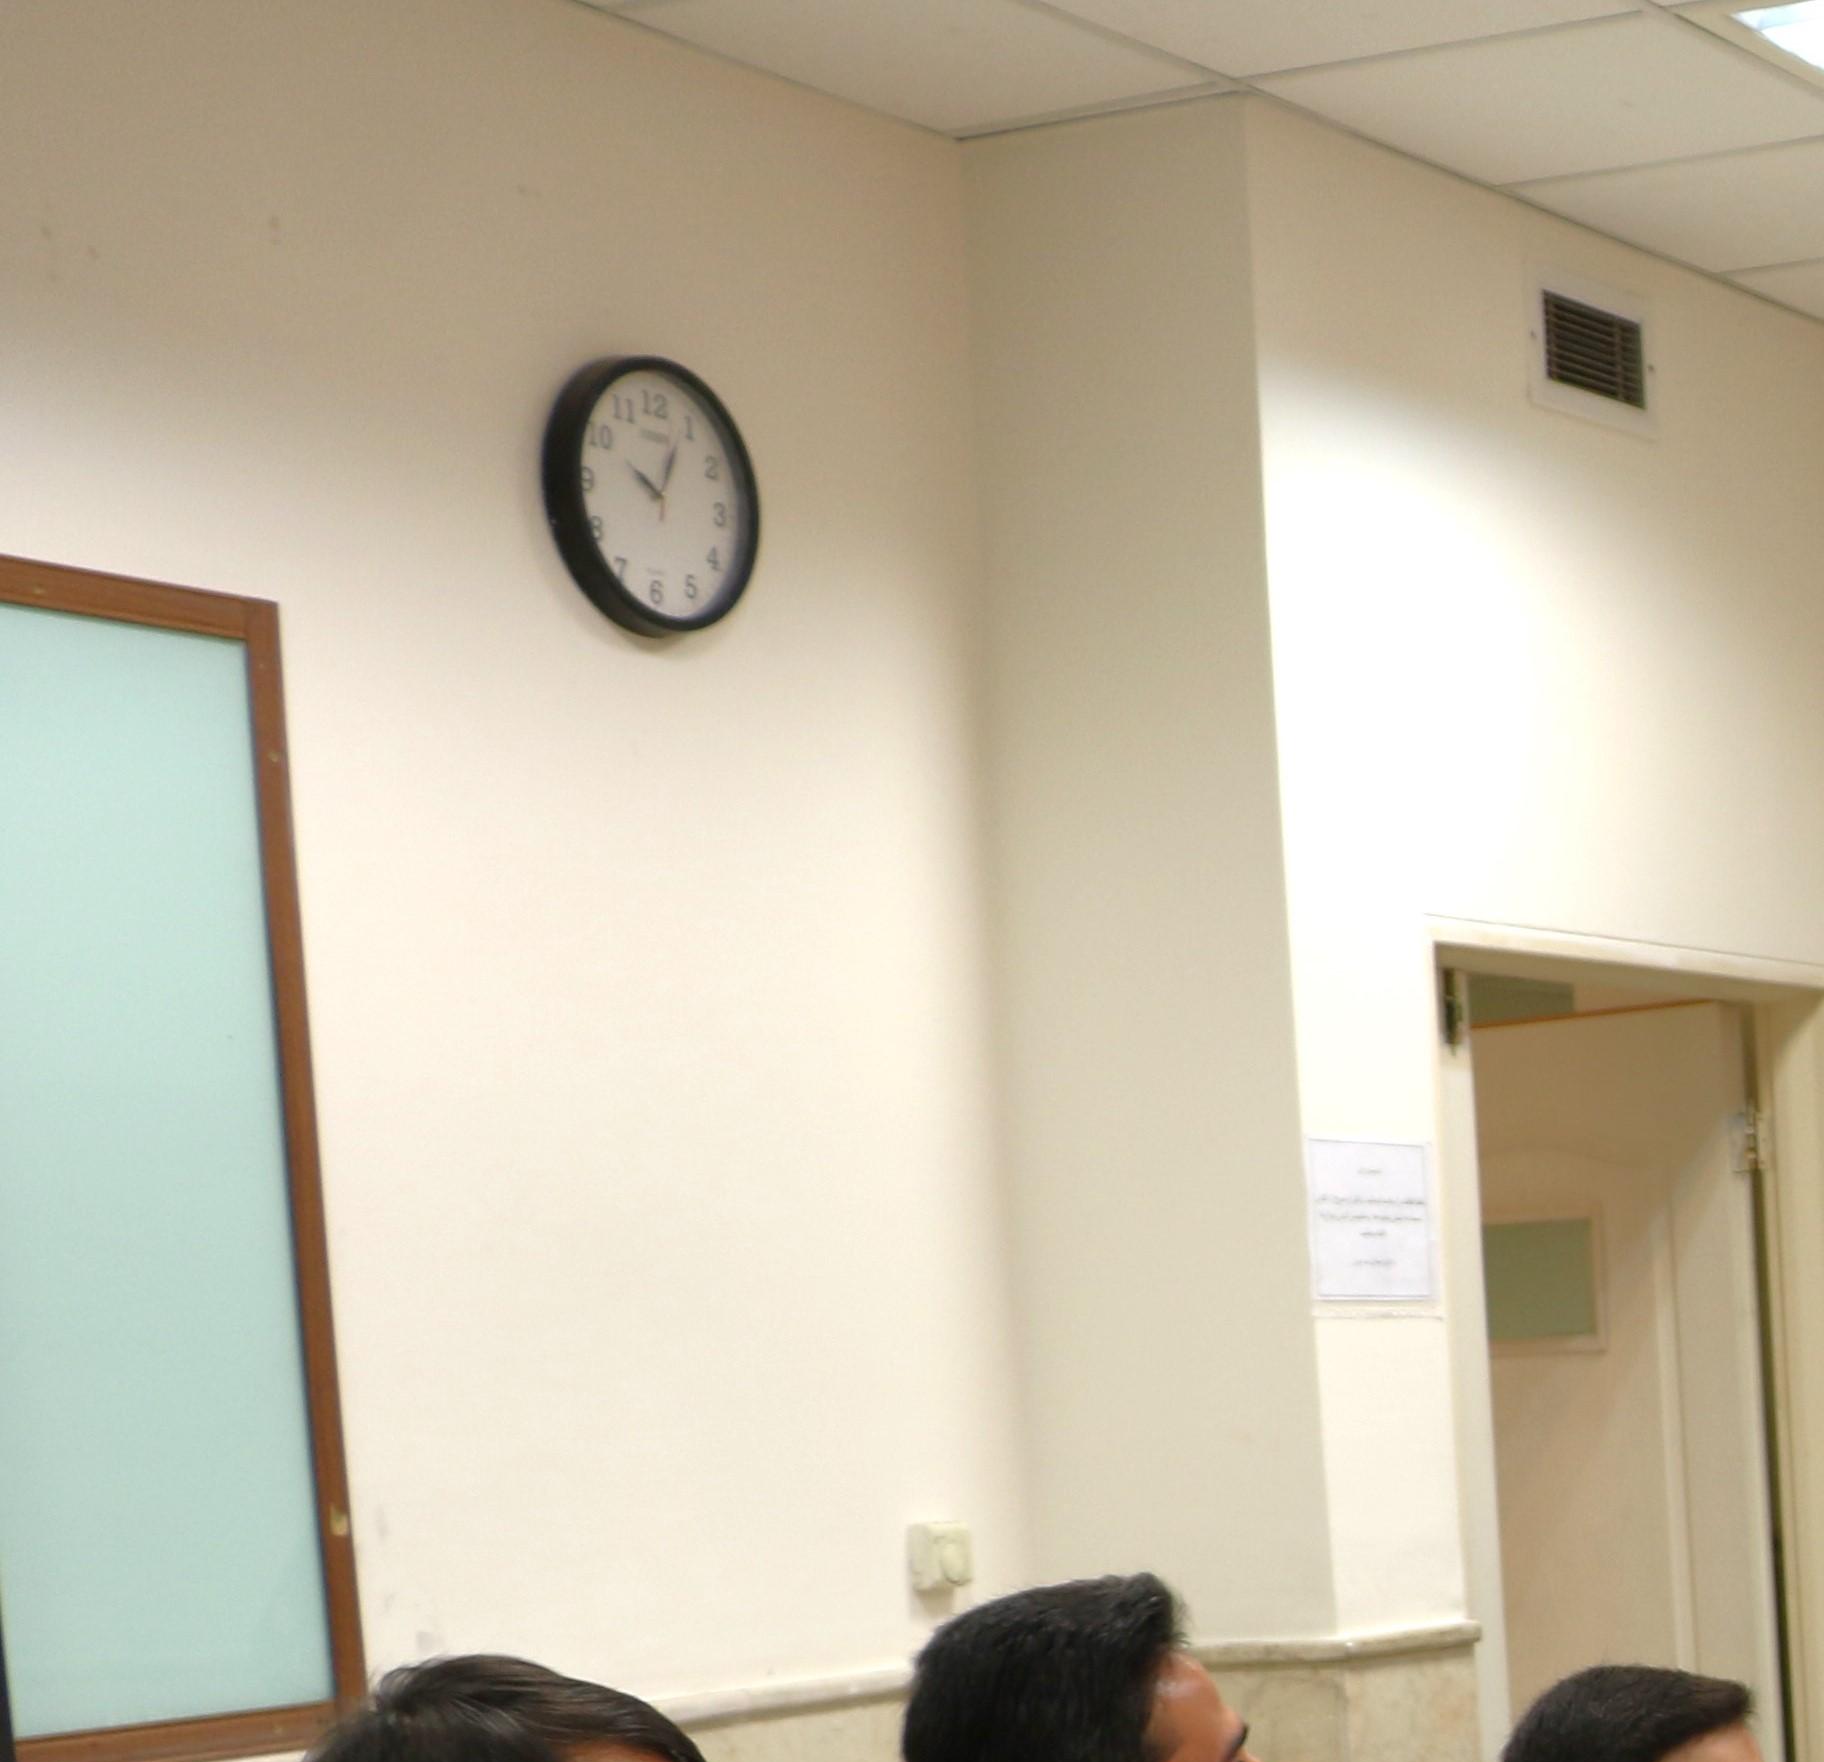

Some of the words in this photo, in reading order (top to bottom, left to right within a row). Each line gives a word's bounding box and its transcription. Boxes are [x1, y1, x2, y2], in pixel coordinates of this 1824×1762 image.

[613, 393, 636, 424] 11
[641, 389, 669, 420] 12
[588, 422, 614, 450] 10
[684, 415, 696, 442] 1
[705, 455, 720, 481] 2
[713, 502, 728, 529] 3
[614, 556, 627, 584] 7
[706, 546, 721, 571] 4
[649, 580, 665, 605] 6
[685, 574, 698, 600] 5
